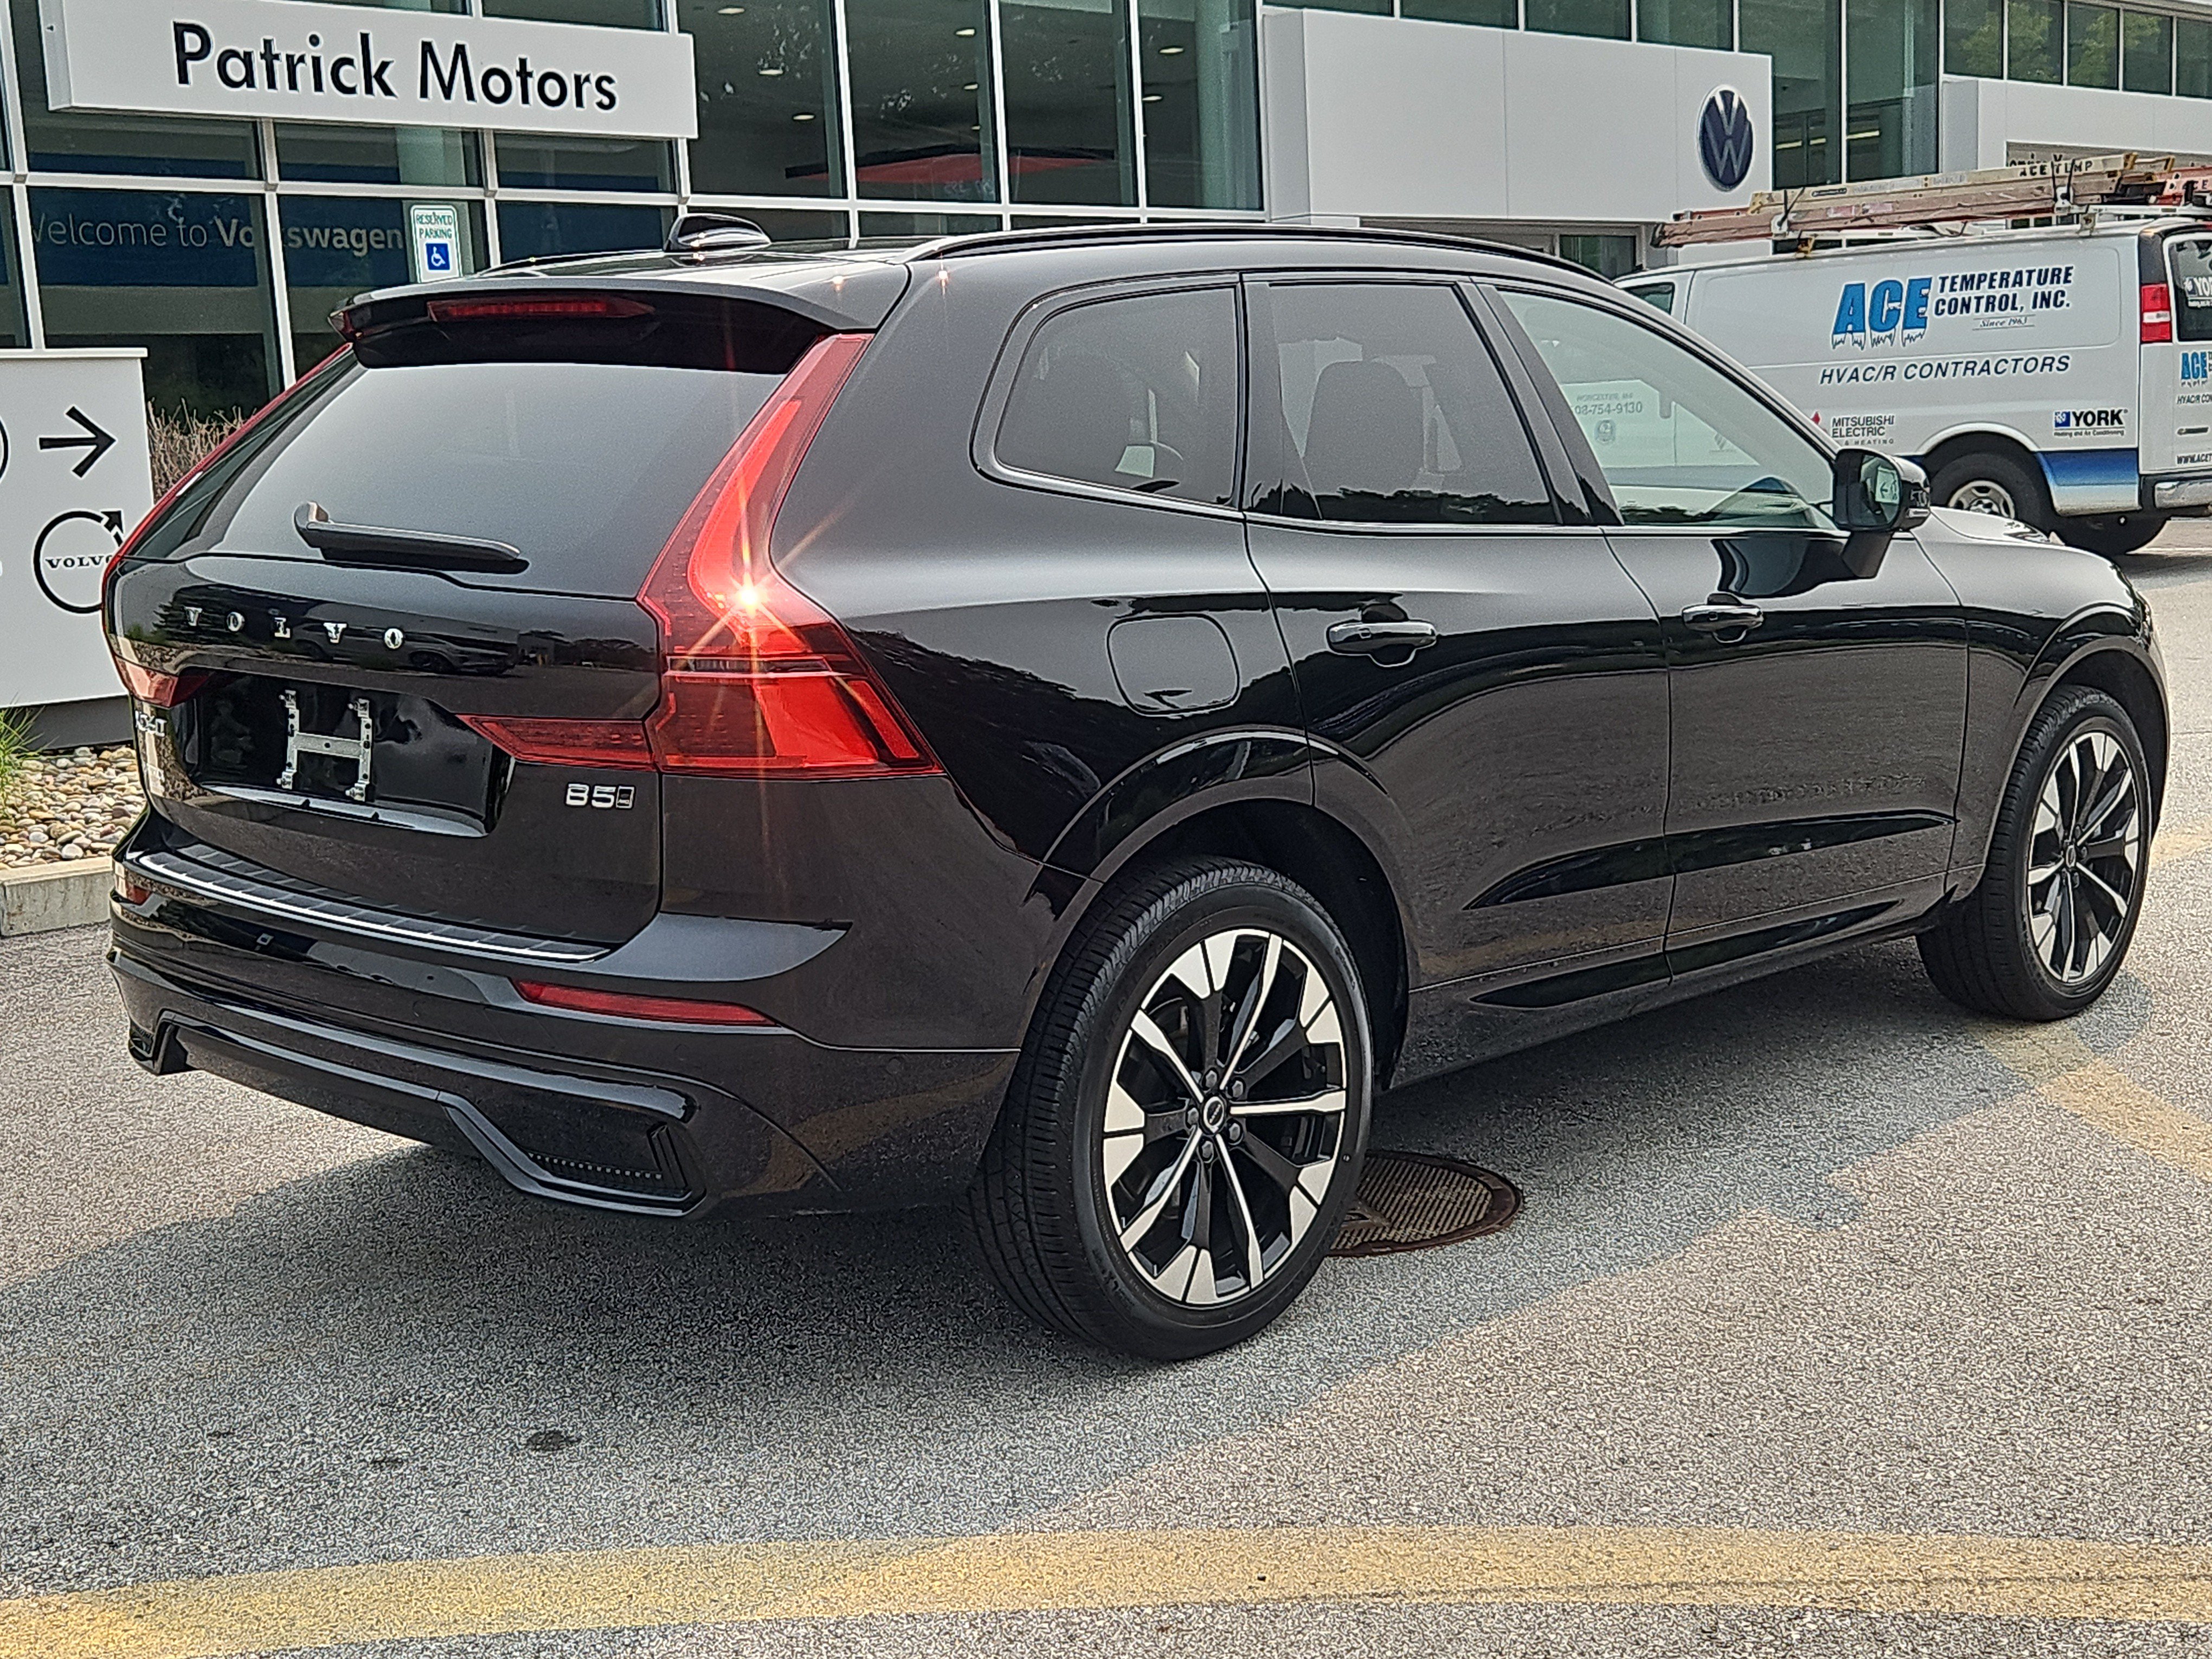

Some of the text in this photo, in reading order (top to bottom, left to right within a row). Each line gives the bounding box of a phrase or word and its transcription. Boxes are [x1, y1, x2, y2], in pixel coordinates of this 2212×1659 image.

[173, 21, 616, 110] Patrick Motors
[416, 214, 452, 225] RESERVED
[176, 217, 207, 247] to
[216, 217, 403, 257] Voswagen
[419, 228, 452, 239] PARKING
[1832, 266, 2074, 344] ACE TEMPERATURE
[1934, 290, 2070, 317] CONTROL, INC.
[1820, 355, 2070, 385] HVAC/R CONTRACTORS
[2181, 352, 2208, 380] ACE
[1574, 401, 1643, 415] 08-754-9130
[1832, 415, 1895, 427] MITSUBISHI
[1831, 426, 1886, 438] ELECTRIC
[45, 555, 112, 569] VOLV
[184, 606, 404, 650] VOLVO
[565, 783, 617, 808] B5
